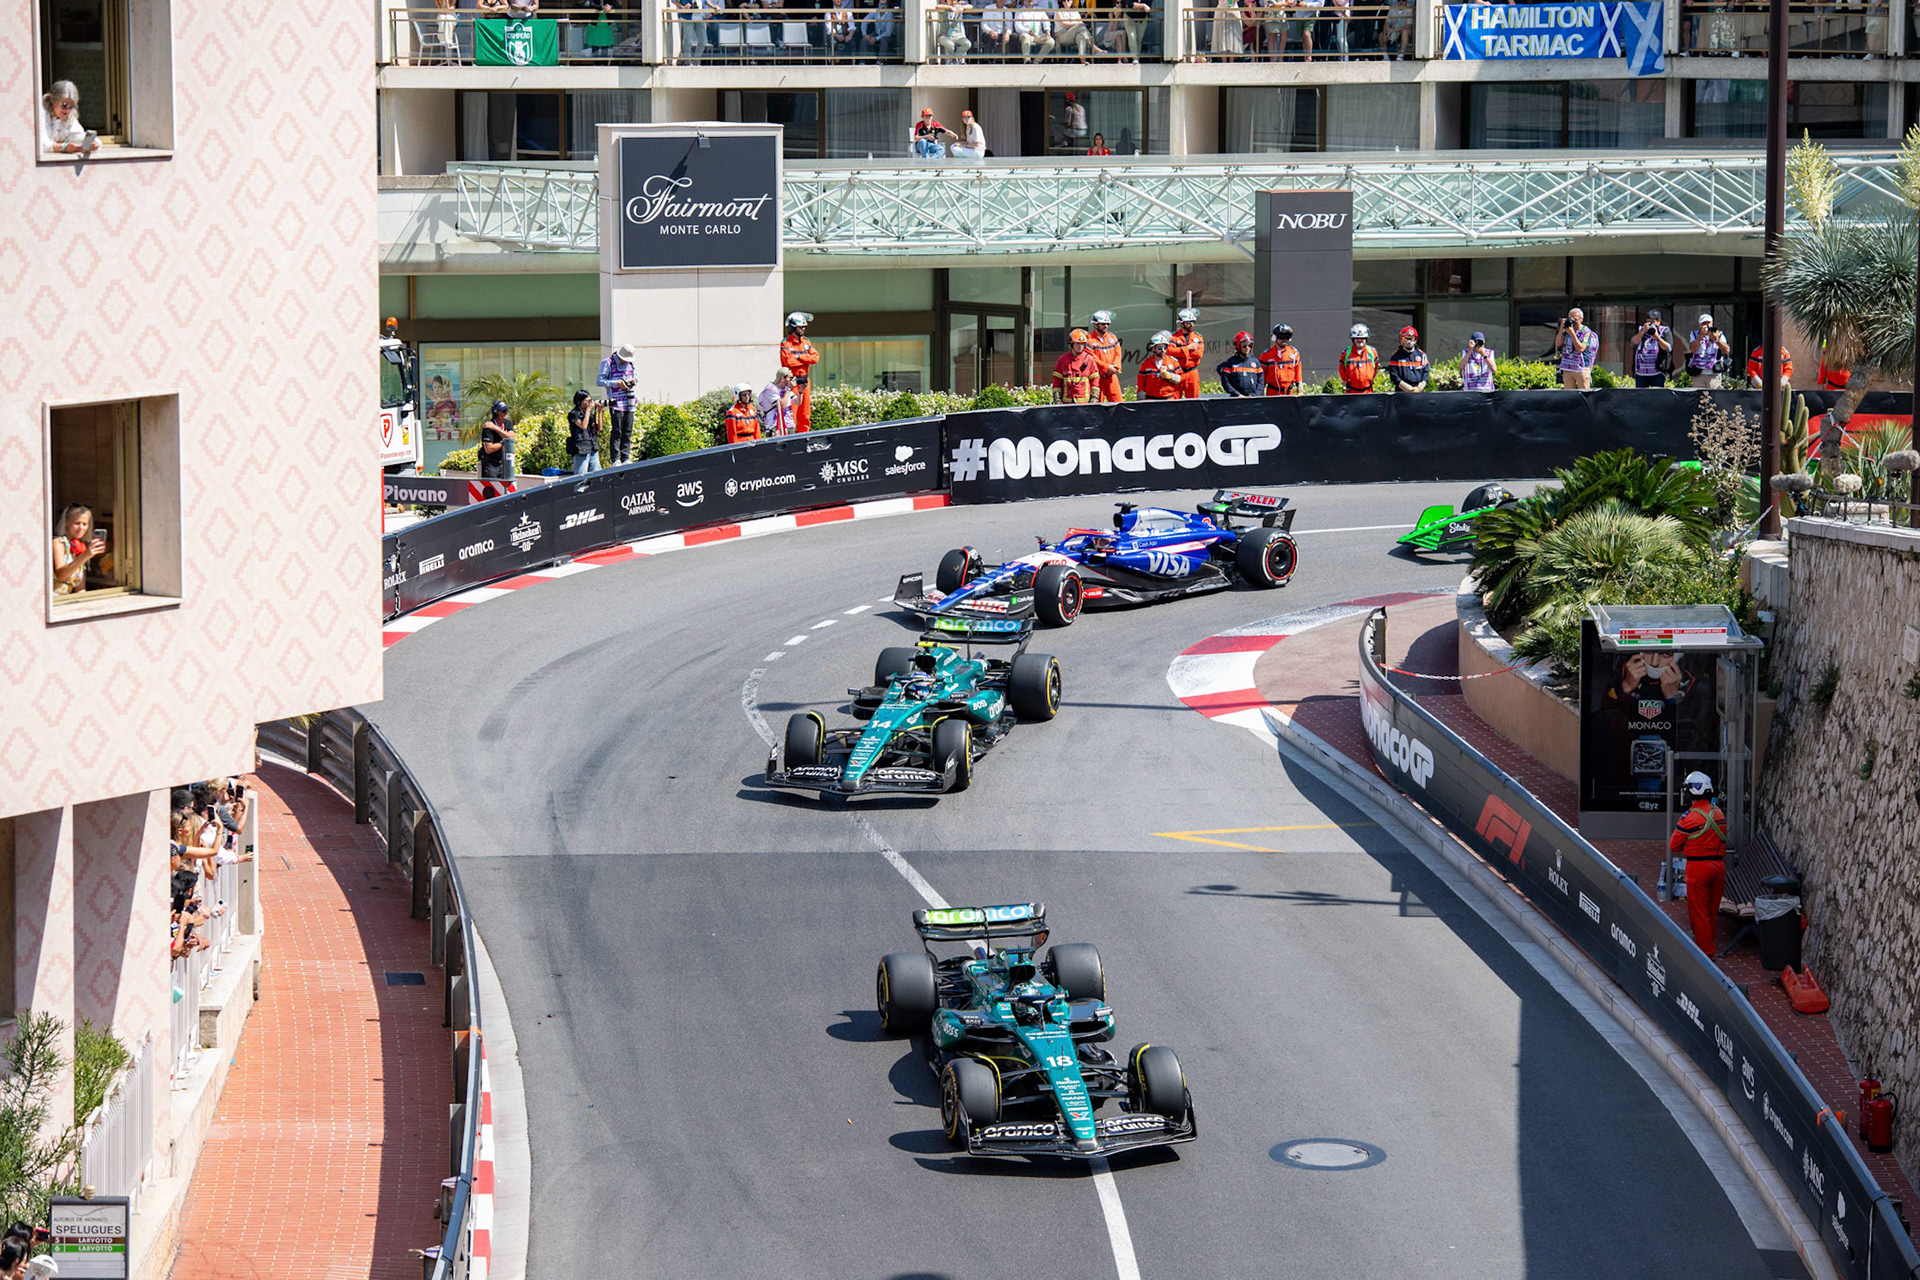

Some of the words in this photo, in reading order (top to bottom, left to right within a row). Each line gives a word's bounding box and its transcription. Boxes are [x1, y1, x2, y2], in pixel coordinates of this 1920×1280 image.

[1471, 6, 1595, 29] HAMILTON
[1480, 33, 1585, 57] TARMAC
[626, 174, 773, 225] Fairmont
[659, 224, 700, 235] MONTE
[704, 224, 741, 235] CARLO
[1276, 213, 1348, 230] NOBU
[949, 422, 1282, 483] #MonacoGP
[836, 458, 869, 477] MSC
[885, 460, 926, 476] salesforce
[739, 473, 796, 493] crypto.com
[836, 473, 870, 484] CRUISES
[384, 485, 448, 503] Piovano
[676, 480, 704, 498] aws
[620, 490, 655, 511] QATAR
[628, 502, 656, 516] AIRWAYS
[560, 508, 605, 531] DHL
[1448, 522, 1471, 534] Stake
[511, 524, 540, 542] Heineken
[458, 538, 495, 560] aramco
[418, 553, 445, 575] PIRELLI
[1149, 551, 1191, 577] VISA
[383, 570, 406, 590] ROLEX
[941, 618, 1017, 632] aramco
[972, 699, 988, 711] BOSS
[1641, 700, 1660, 708] TAG
[871, 720, 892, 729] 14
[1628, 721, 1672, 730] MONACO
[791, 766, 839, 778] aramco
[877, 768, 937, 781] aramco
[1548, 866, 1569, 897] ROLEX
[931, 904, 1027, 924] aramco
[1579, 890, 1601, 924] PIRELLI
[1610, 922, 1637, 958] aramco
[1676, 991, 1704, 1032] DHL
[1714, 1024, 1734, 1059] QATAR
[1045, 1055, 1074, 1067] 18
[1742, 1056, 1755, 1087] aws
[984, 1123, 1055, 1138] aramco
[1105, 1116, 1165, 1132] aramco
[1769, 1107, 1794, 1151] crypto.com
[1809, 1156, 1825, 1196] MSC
[55, 1225, 122, 1234] SPELUGUES
